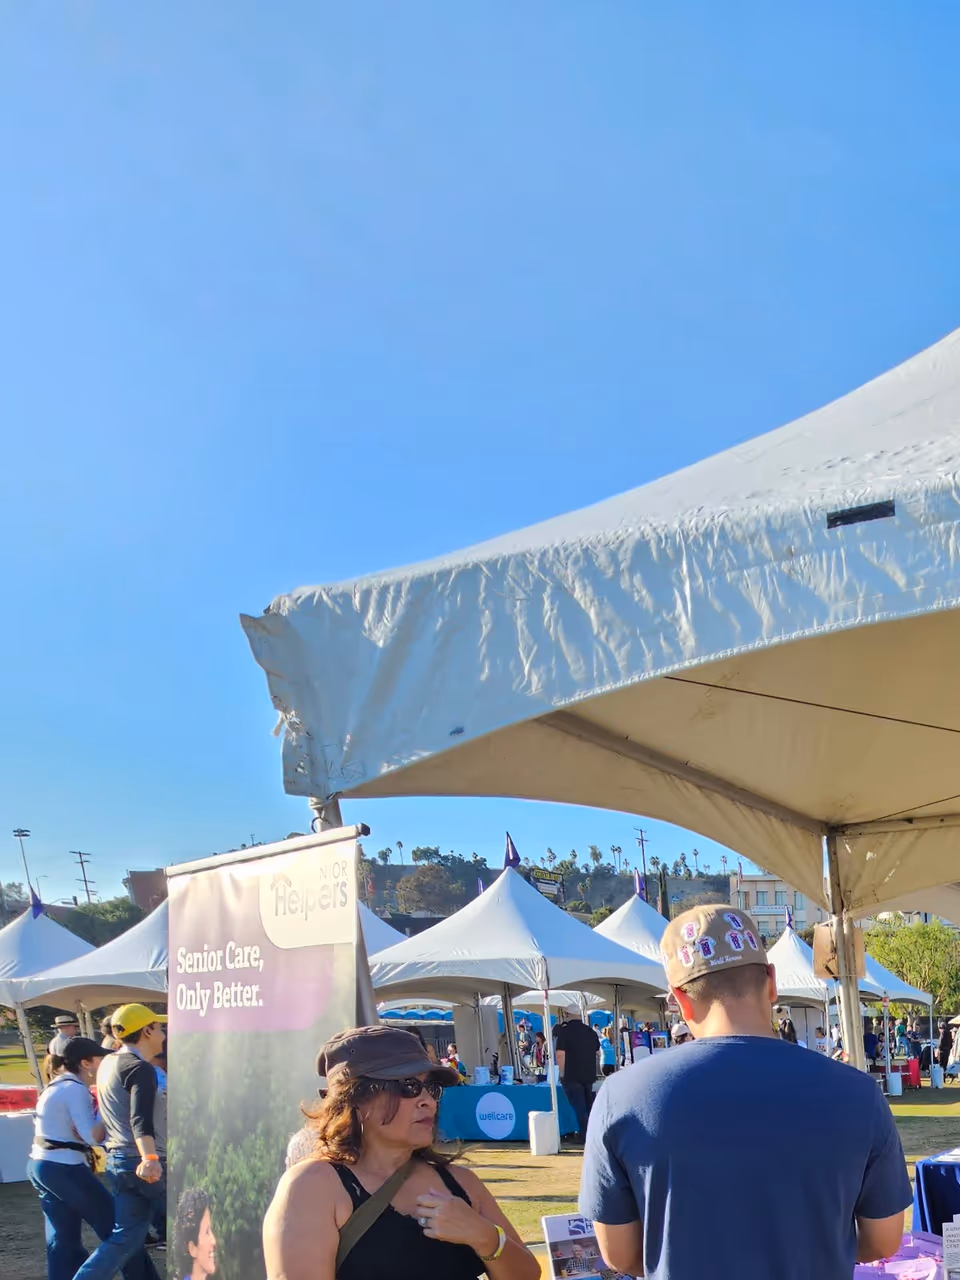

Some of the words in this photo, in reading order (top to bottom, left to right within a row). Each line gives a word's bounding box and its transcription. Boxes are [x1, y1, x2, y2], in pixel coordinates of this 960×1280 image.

[319, 860, 348, 881] NIOR
[273, 880, 349, 921] Helpers
[177, 944, 223, 974] Senior
[225, 940, 265, 972] Care,
[176, 981, 211, 1017] Only
[213, 979, 264, 1009] Better.
[480, 1112, 514, 1121] wellcare
